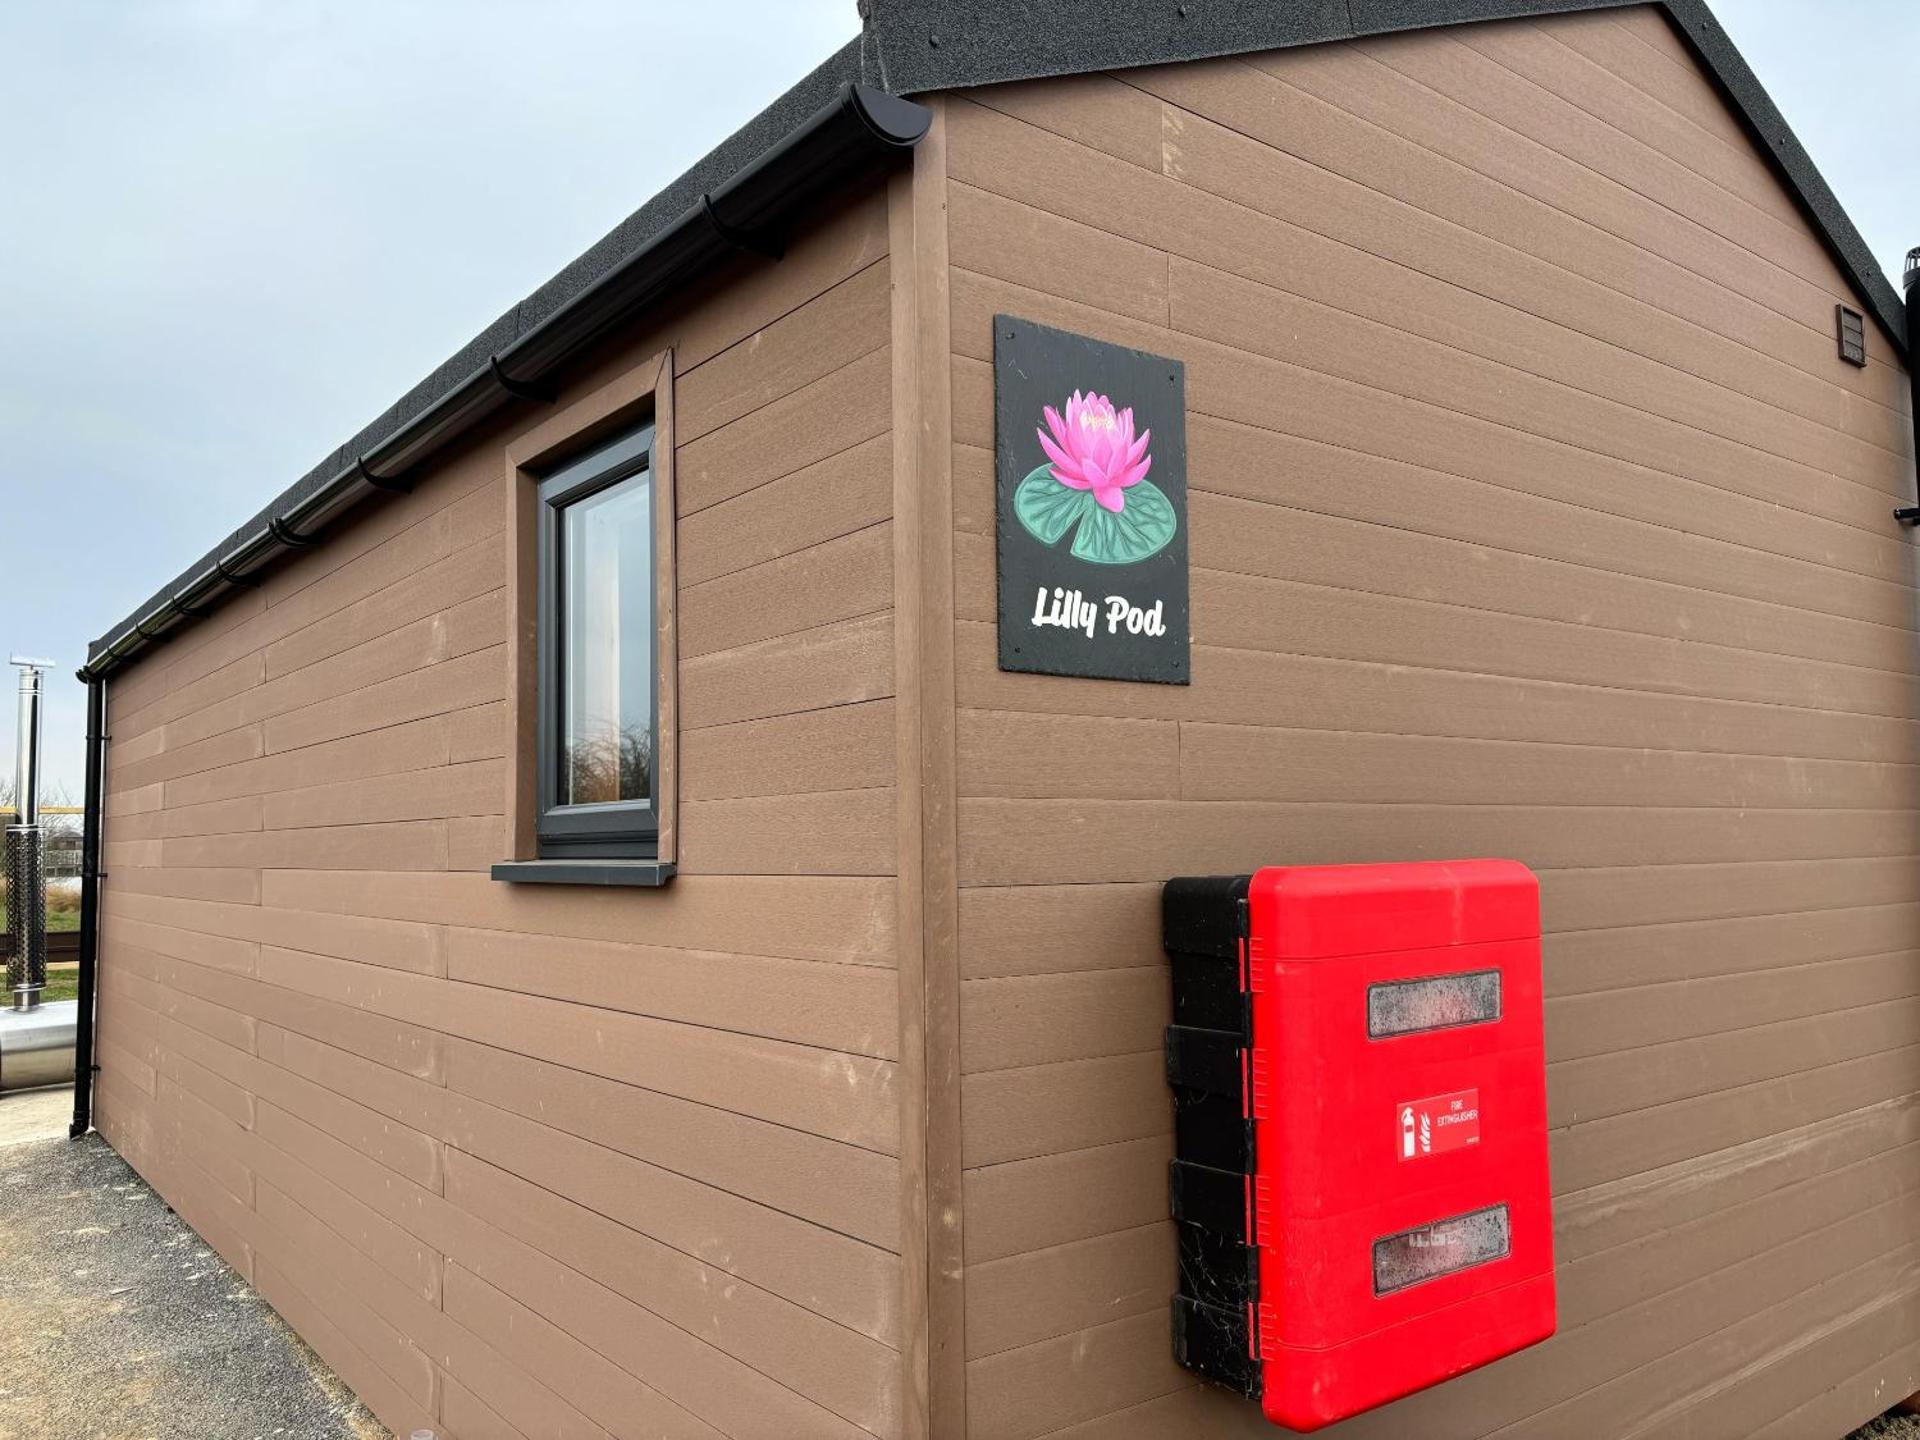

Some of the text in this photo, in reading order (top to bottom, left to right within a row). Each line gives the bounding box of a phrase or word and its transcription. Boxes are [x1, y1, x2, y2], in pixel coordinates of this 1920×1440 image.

[1031, 586, 1167, 639] Lilly Pod
[1450, 1099, 1464, 1112] FIRE
[1437, 1109, 1479, 1127] EXTINGUISHER
